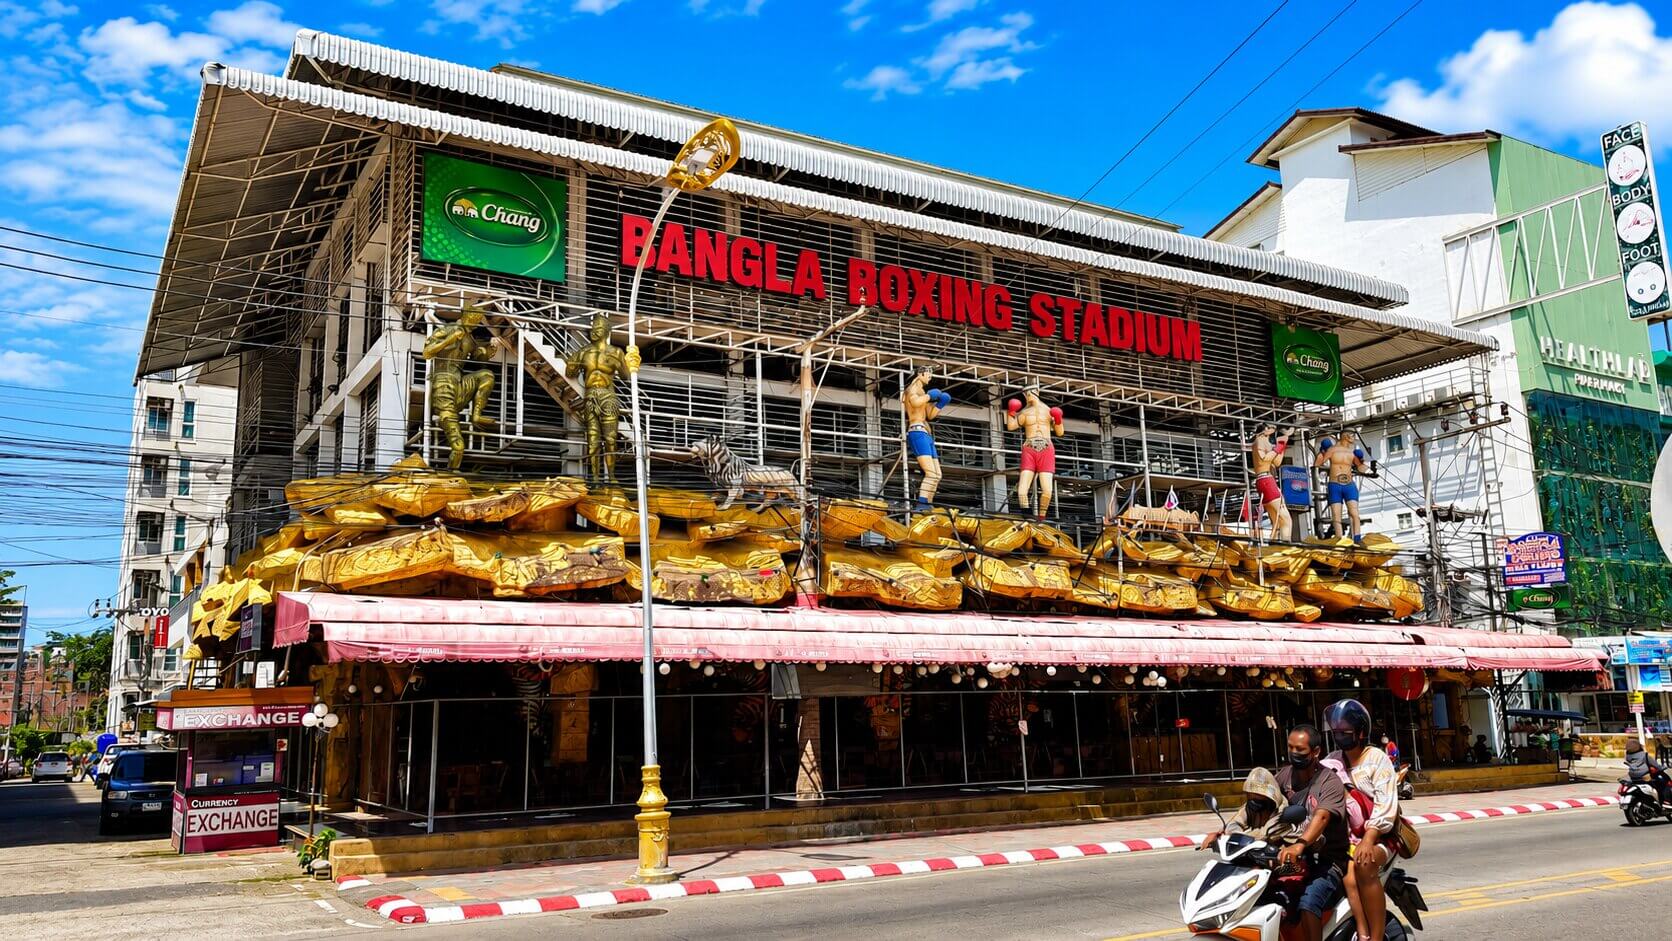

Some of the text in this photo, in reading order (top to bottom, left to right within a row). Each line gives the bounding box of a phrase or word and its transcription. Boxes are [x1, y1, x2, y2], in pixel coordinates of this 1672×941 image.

[1604, 126, 1641, 148] FACE
[1612, 184, 1650, 206] BODY
[481, 204, 541, 233] Chang
[1622, 243, 1661, 264] FOOT
[622, 212, 1203, 362] BANGLA BOXING STADIUM
[1300, 354, 1329, 373] Chang
[141, 607, 169, 616] OYO
[184, 711, 300, 728] EXCHANGE
[187, 809, 278, 833] EXCHANGE
